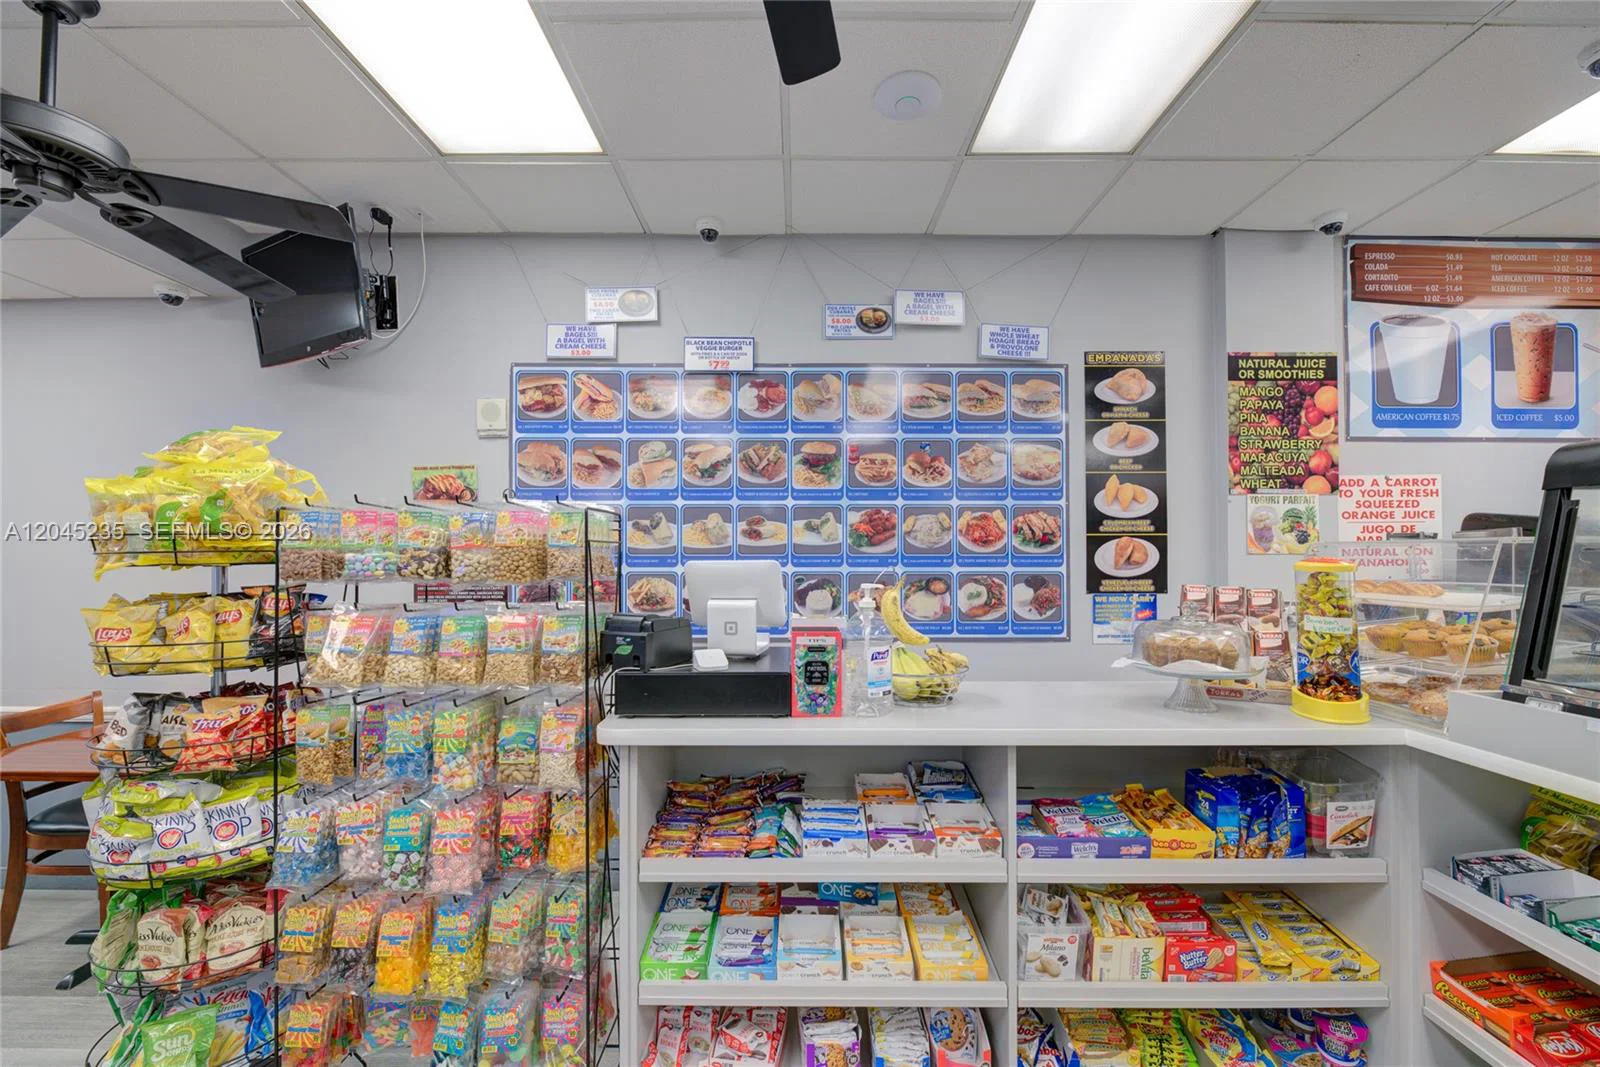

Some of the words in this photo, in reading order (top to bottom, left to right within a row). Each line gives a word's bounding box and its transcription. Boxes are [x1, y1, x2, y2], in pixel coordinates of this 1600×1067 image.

[1364, 252, 1395, 260] ESPRESSO
[1504, 254, 1537, 262] CHOCOLATE
[1491, 264, 1502, 272] TEA
[1492, 274, 1523, 283] AMERICAN
[1524, 275, 1544, 283] COFFEE
[1364, 284, 1379, 292] CAFE
[1381, 284, 1393, 292] CON
[1395, 284, 1412, 292] LECHE
[1432, 284, 1439, 292] OZ
[1016, 332, 1040, 340] WHEAT
[997, 344, 1038, 352] PROVOLONE
[1088, 354, 1162, 363] EMPANADAS
[1239, 359, 1290, 369] NATURAL
[1293, 359, 1326, 369] JUICE
[1239, 370, 1255, 379] OR
[1258, 370, 1324, 379] SMOOTHIES
[1240, 387, 1284, 397] MANGO
[1240, 400, 1284, 410] PAPAYA
[1240, 412, 1267, 423] PIÑA
[1376, 412, 1415, 421] AMERICAN
[1416, 412, 1442, 421] COFFEE
[1443, 412, 1460, 422] $1.75
[1496, 413, 1514, 422] ICED
[1515, 413, 1543, 422] COFFEE
[1554, 414, 1575, 422] $5.00
[1240, 427, 1290, 436] BANANA
[1240, 440, 1323, 450] STRAWBERRY
[1240, 452, 1307, 462] MARACUYA
[1240, 466, 1305, 476] MALTEADA
[1240, 479, 1281, 489] WHEAT
[1340, 478, 1364, 487] ADD
[1370, 478, 1380, 487] A
[1385, 478, 1437, 487] CARROT
[1340, 489, 1353, 498] TO
[1359, 488, 1394, 498] YOUR
[1400, 488, 1440, 498] FRESH
[1250, 495, 1281, 505] YOGURT
[1282, 495, 1316, 505] PARFAIT
[1356, 499, 1420, 509] SQUEEZED
[1342, 510, 1396, 520] ORANGE
[1401, 510, 1436, 520] JUICE
[1360, 525, 1395, 534] JUGO
[1401, 525, 1417, 534] DE
[1342, 548, 1399, 557] NATURAL
[1043, 807, 1081, 817] Welch's
[1090, 813, 1128, 826] Welch's
[1073, 845, 1097, 853] Welch's
[1180, 841, 1197, 850] bon
[675, 887, 698, 896] ONE
[821, 883, 852, 898] ONE
[667, 898, 692, 907] ONE
[662, 924, 688, 932] ONE
[726, 927, 753, 935] ONE
[655, 944, 684, 953] ONE
[1040, 944, 1066, 952] Milano
[1180, 950, 1205, 962] Nutter
[1140, 948, 1153, 980] belVita
[1183, 958, 1208, 969] Butter
[642, 968, 677, 980] ONE
[712, 972, 748, 980] ONE
[1508, 972, 1545, 983] Reese's
[1538, 989, 1575, 999] Reese's
[1435, 981, 1481, 1021] Reese's
[1200, 1028, 1236, 1045] Swedish
[1210, 1038, 1230, 1048] Fish
